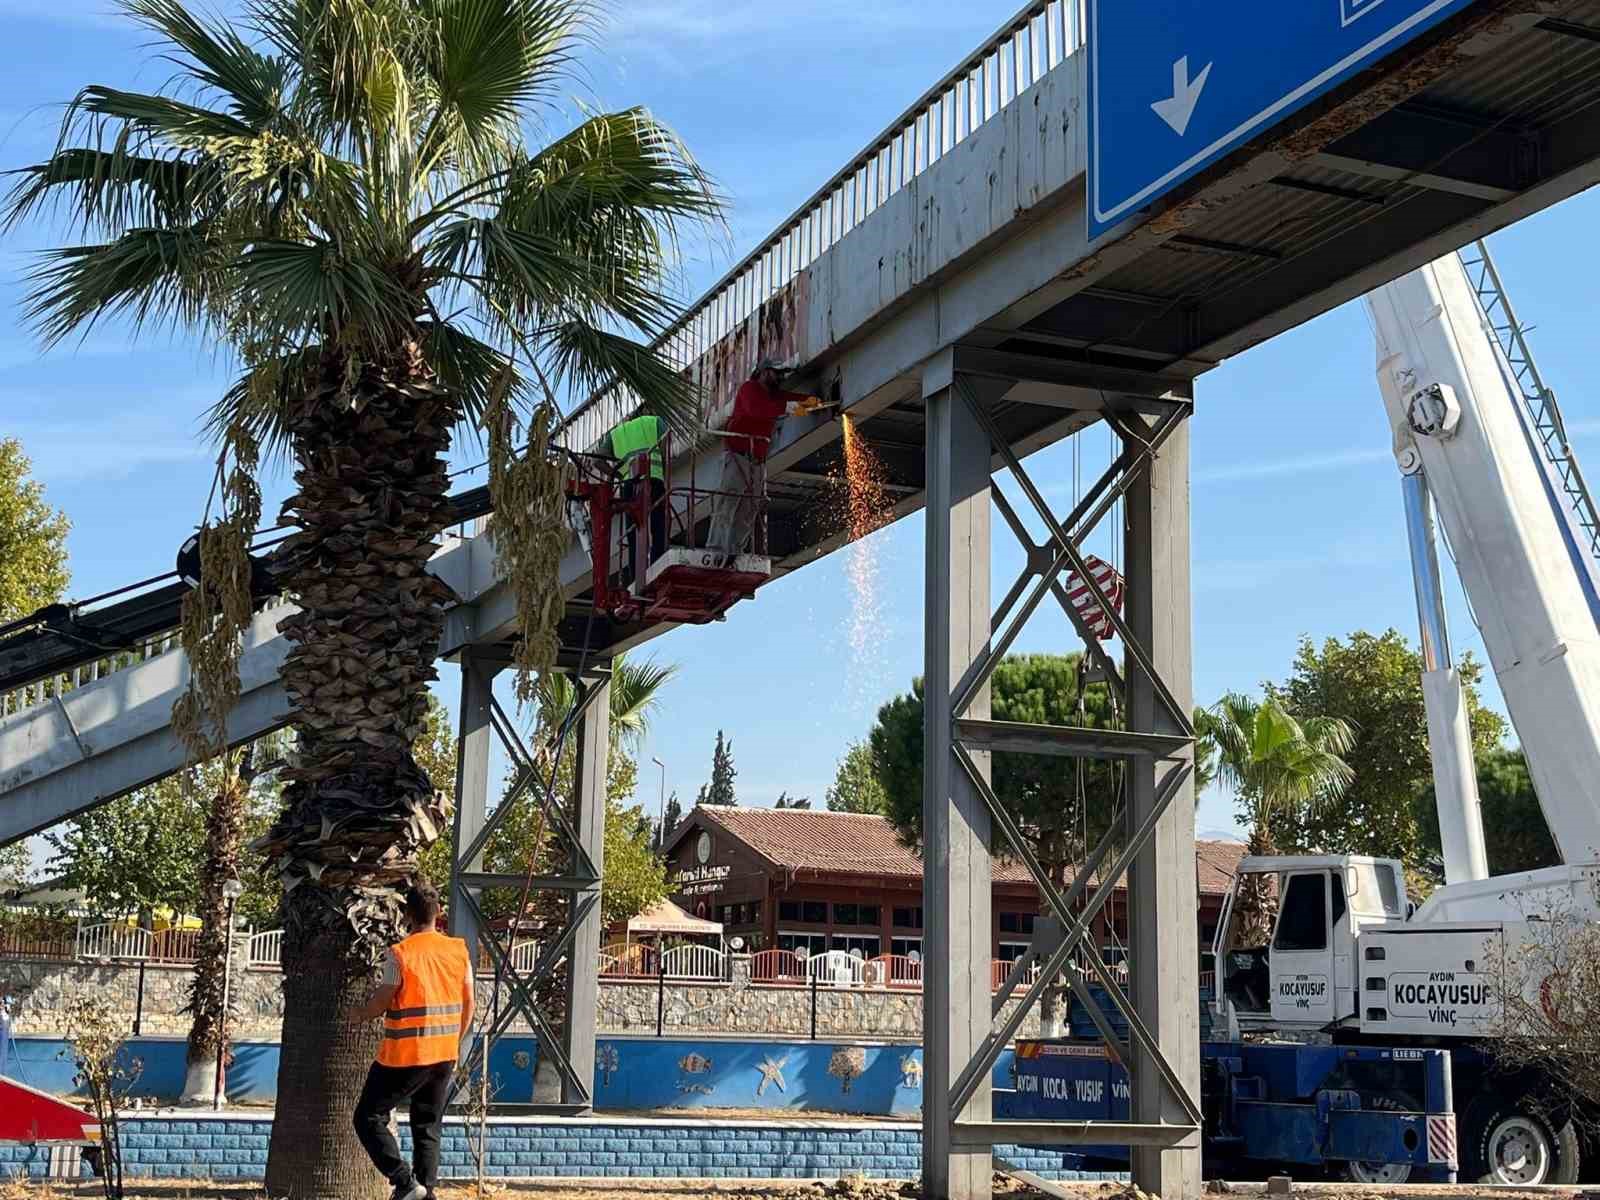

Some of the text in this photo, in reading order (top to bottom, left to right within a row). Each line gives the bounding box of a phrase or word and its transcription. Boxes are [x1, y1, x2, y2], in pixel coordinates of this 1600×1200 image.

[1428, 972, 1455, 982] AYDIN
[1279, 982, 1326, 996] KOCAYUSUF
[1394, 984, 1491, 1005] KOCAYUSUF
[1428, 1005, 1457, 1027] VİNÇ
[1042, 1077, 1068, 1100] KOCA
[1075, 1079, 1104, 1102] YUSUF
[1111, 1079, 1131, 1099] VİN
